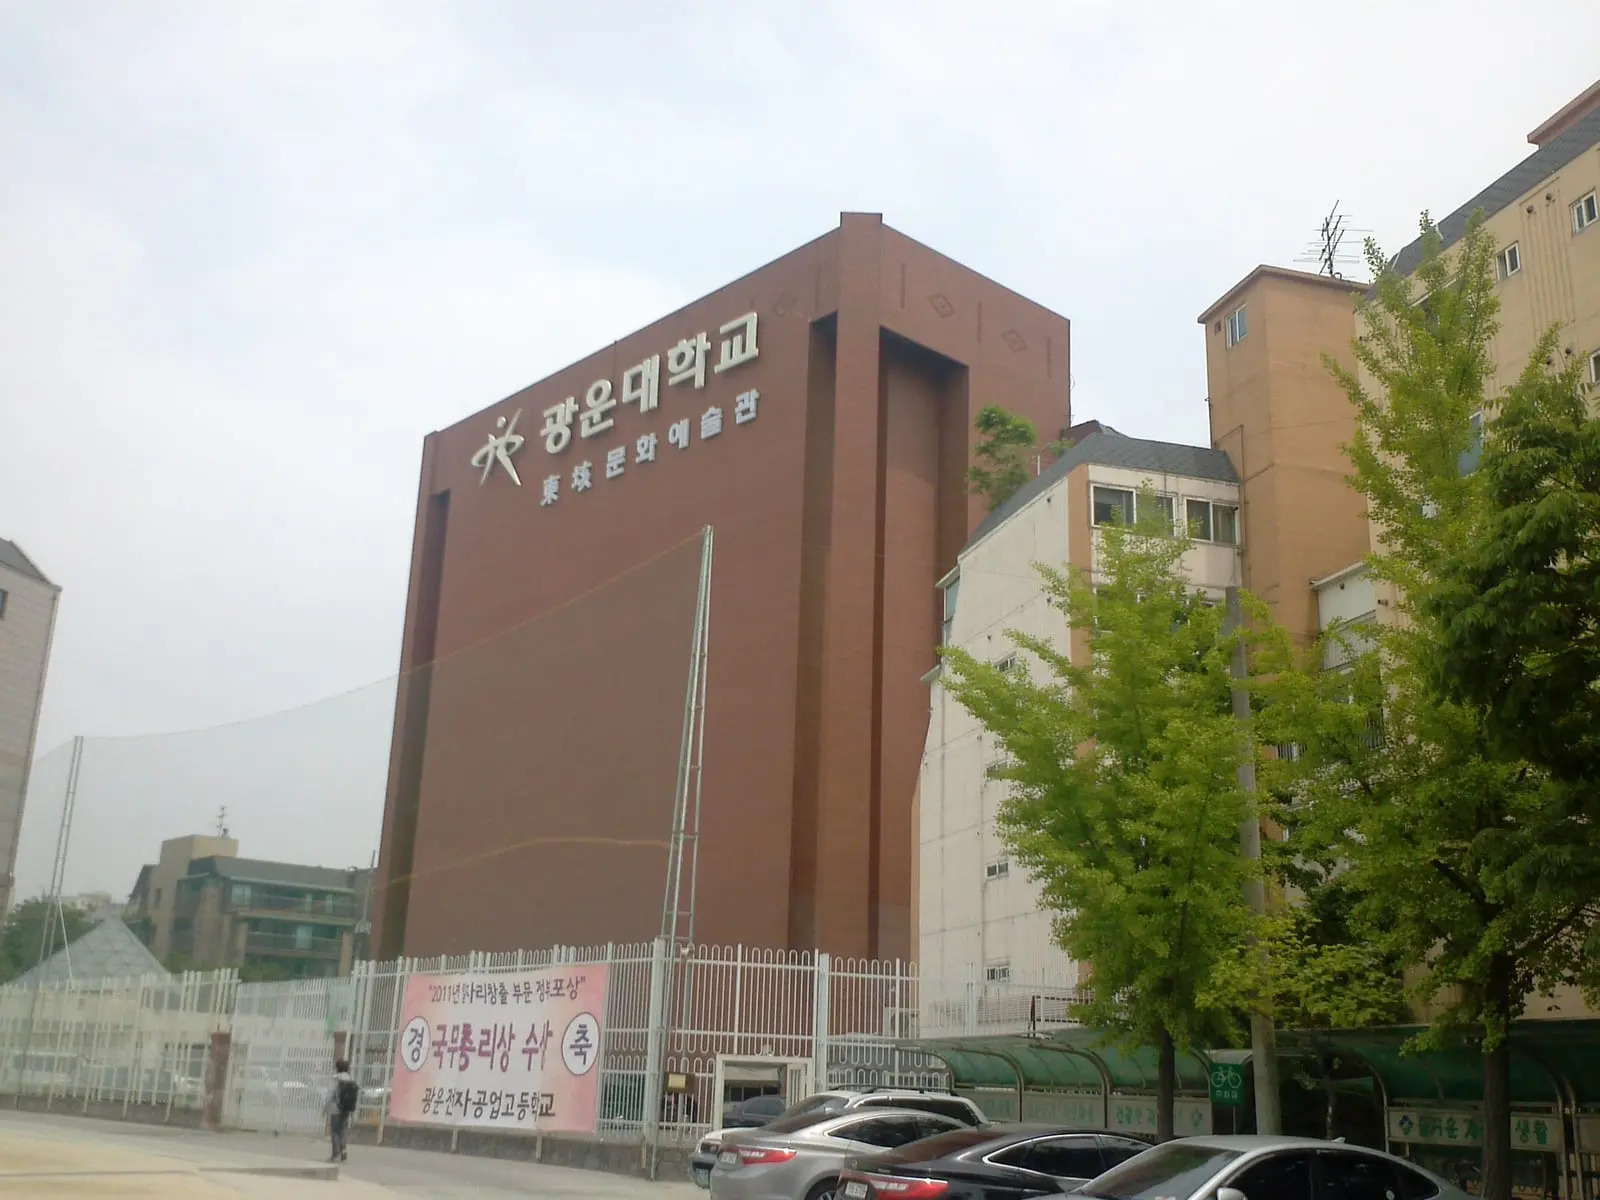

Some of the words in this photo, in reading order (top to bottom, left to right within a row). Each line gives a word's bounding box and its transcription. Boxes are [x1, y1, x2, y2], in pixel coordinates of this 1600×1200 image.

[540, 312, 759, 454] 광운대학교
[408, 1026, 425, 1063] 경
[432, 1023, 516, 1072] 국무총리상
[570, 1024, 592, 1065] 축
[421, 1087, 556, 1121] 광운전자공업고등학교
